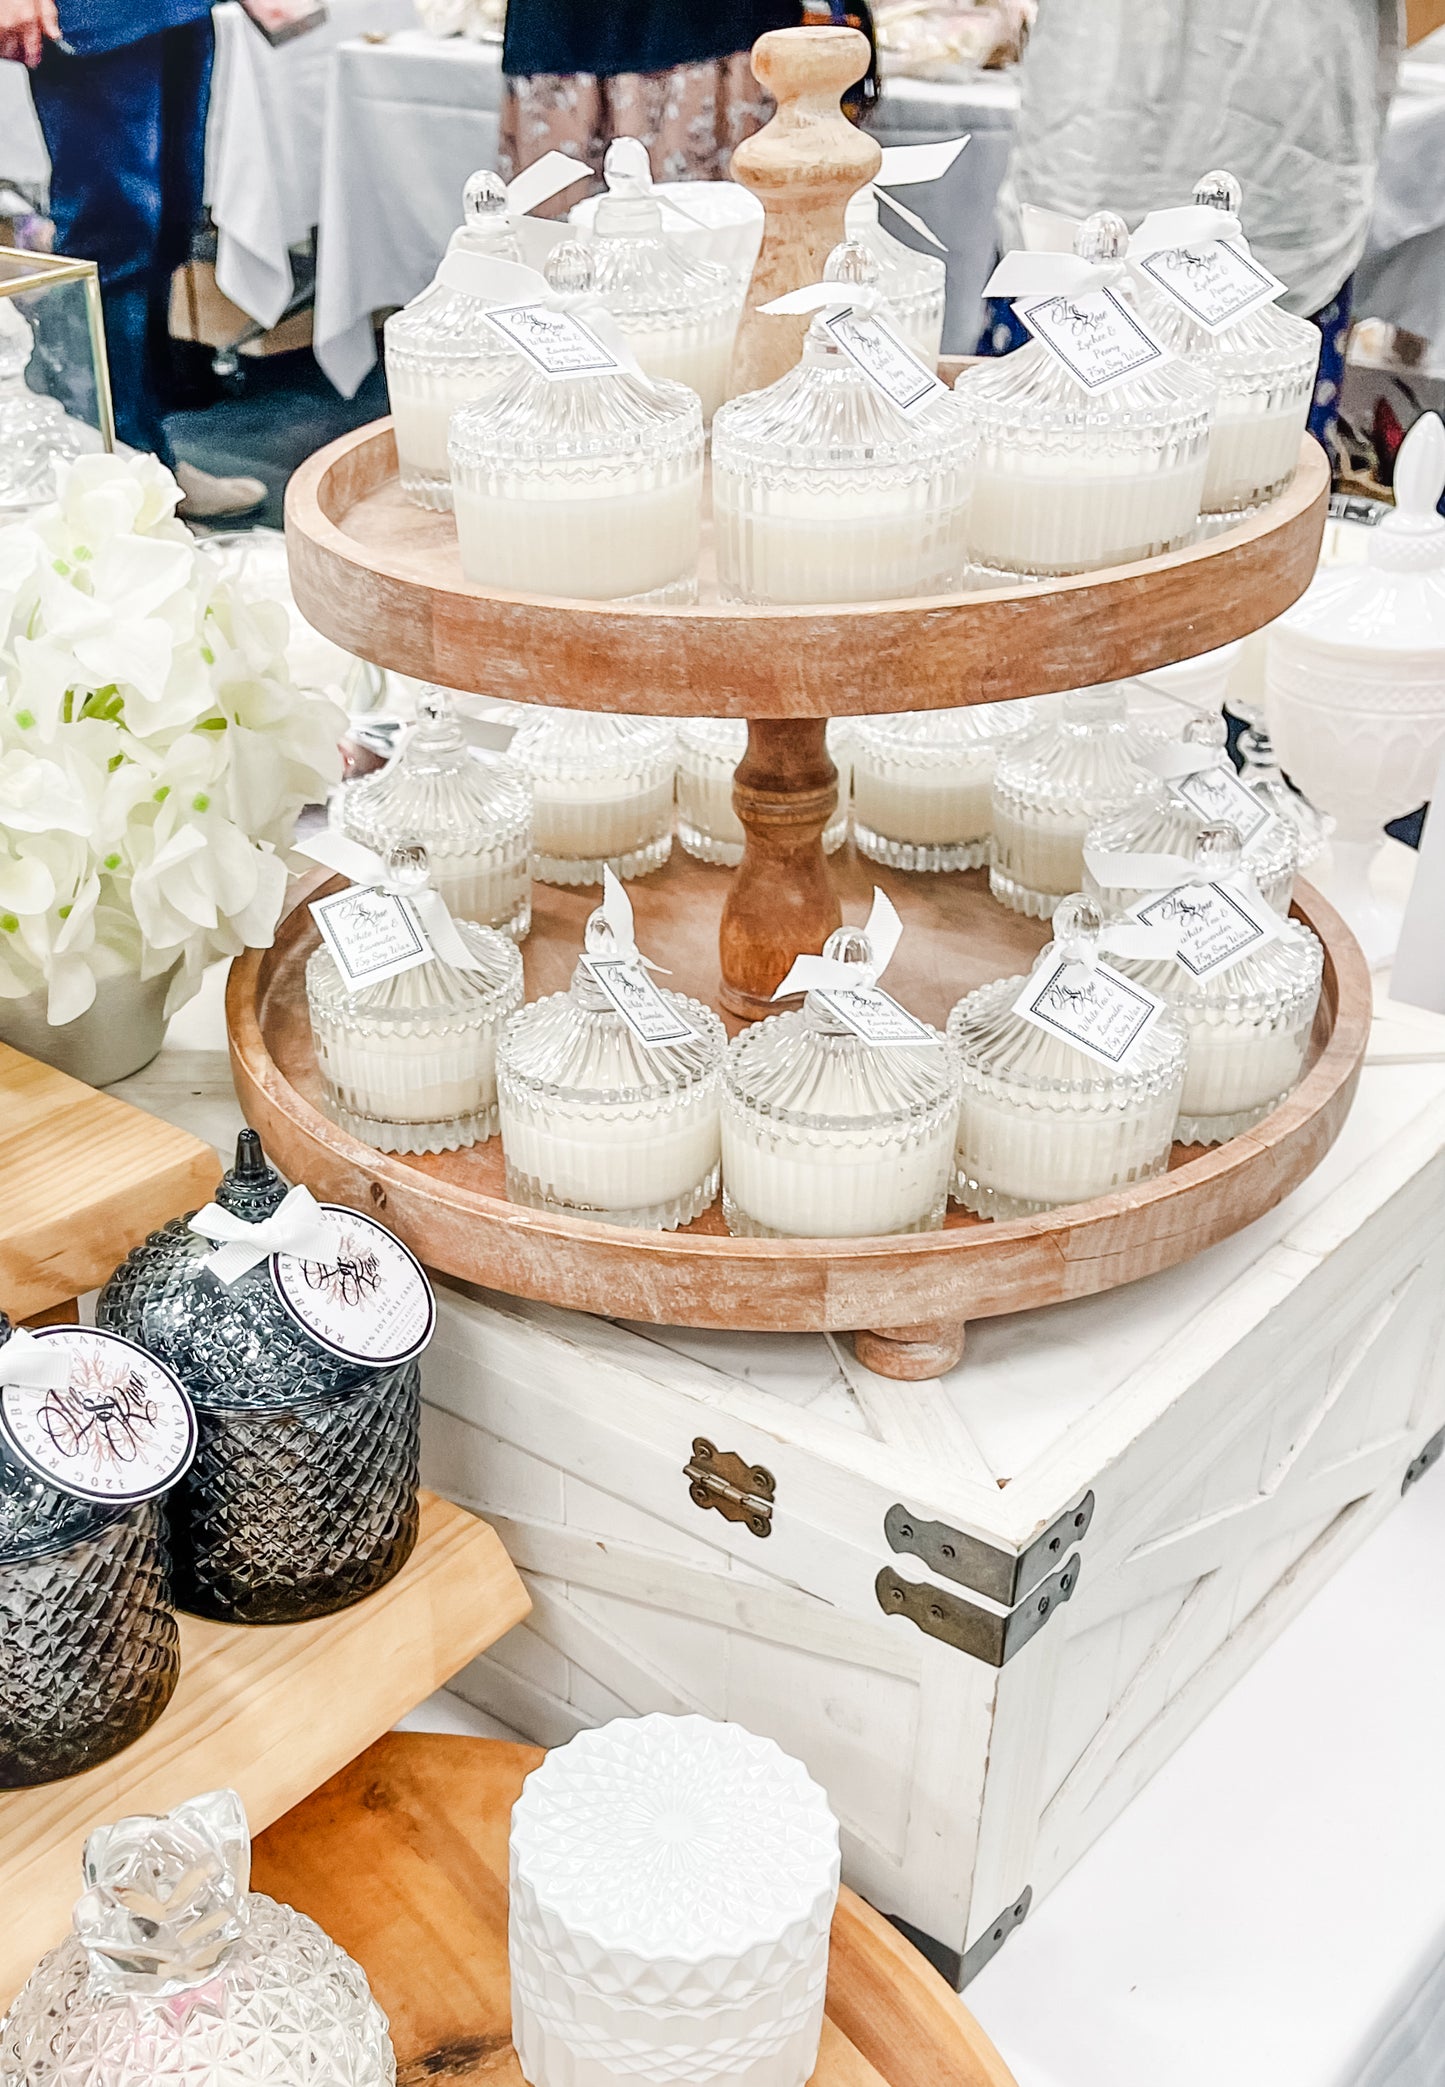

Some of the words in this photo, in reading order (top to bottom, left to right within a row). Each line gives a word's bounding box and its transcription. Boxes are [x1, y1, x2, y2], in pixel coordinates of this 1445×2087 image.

[282, 1253, 345, 1343] RASPBERR
[321, 1213, 405, 1262] SEWATER
[50, 1335, 108, 1348] REAM
[141, 1361, 172, 1391] SOY
[7, 1394, 59, 1469] RASPBE
[98, 1370, 158, 1462] Rose
[154, 1404, 185, 1476] CANDLE
[74, 1471, 127, 1489] 320G
